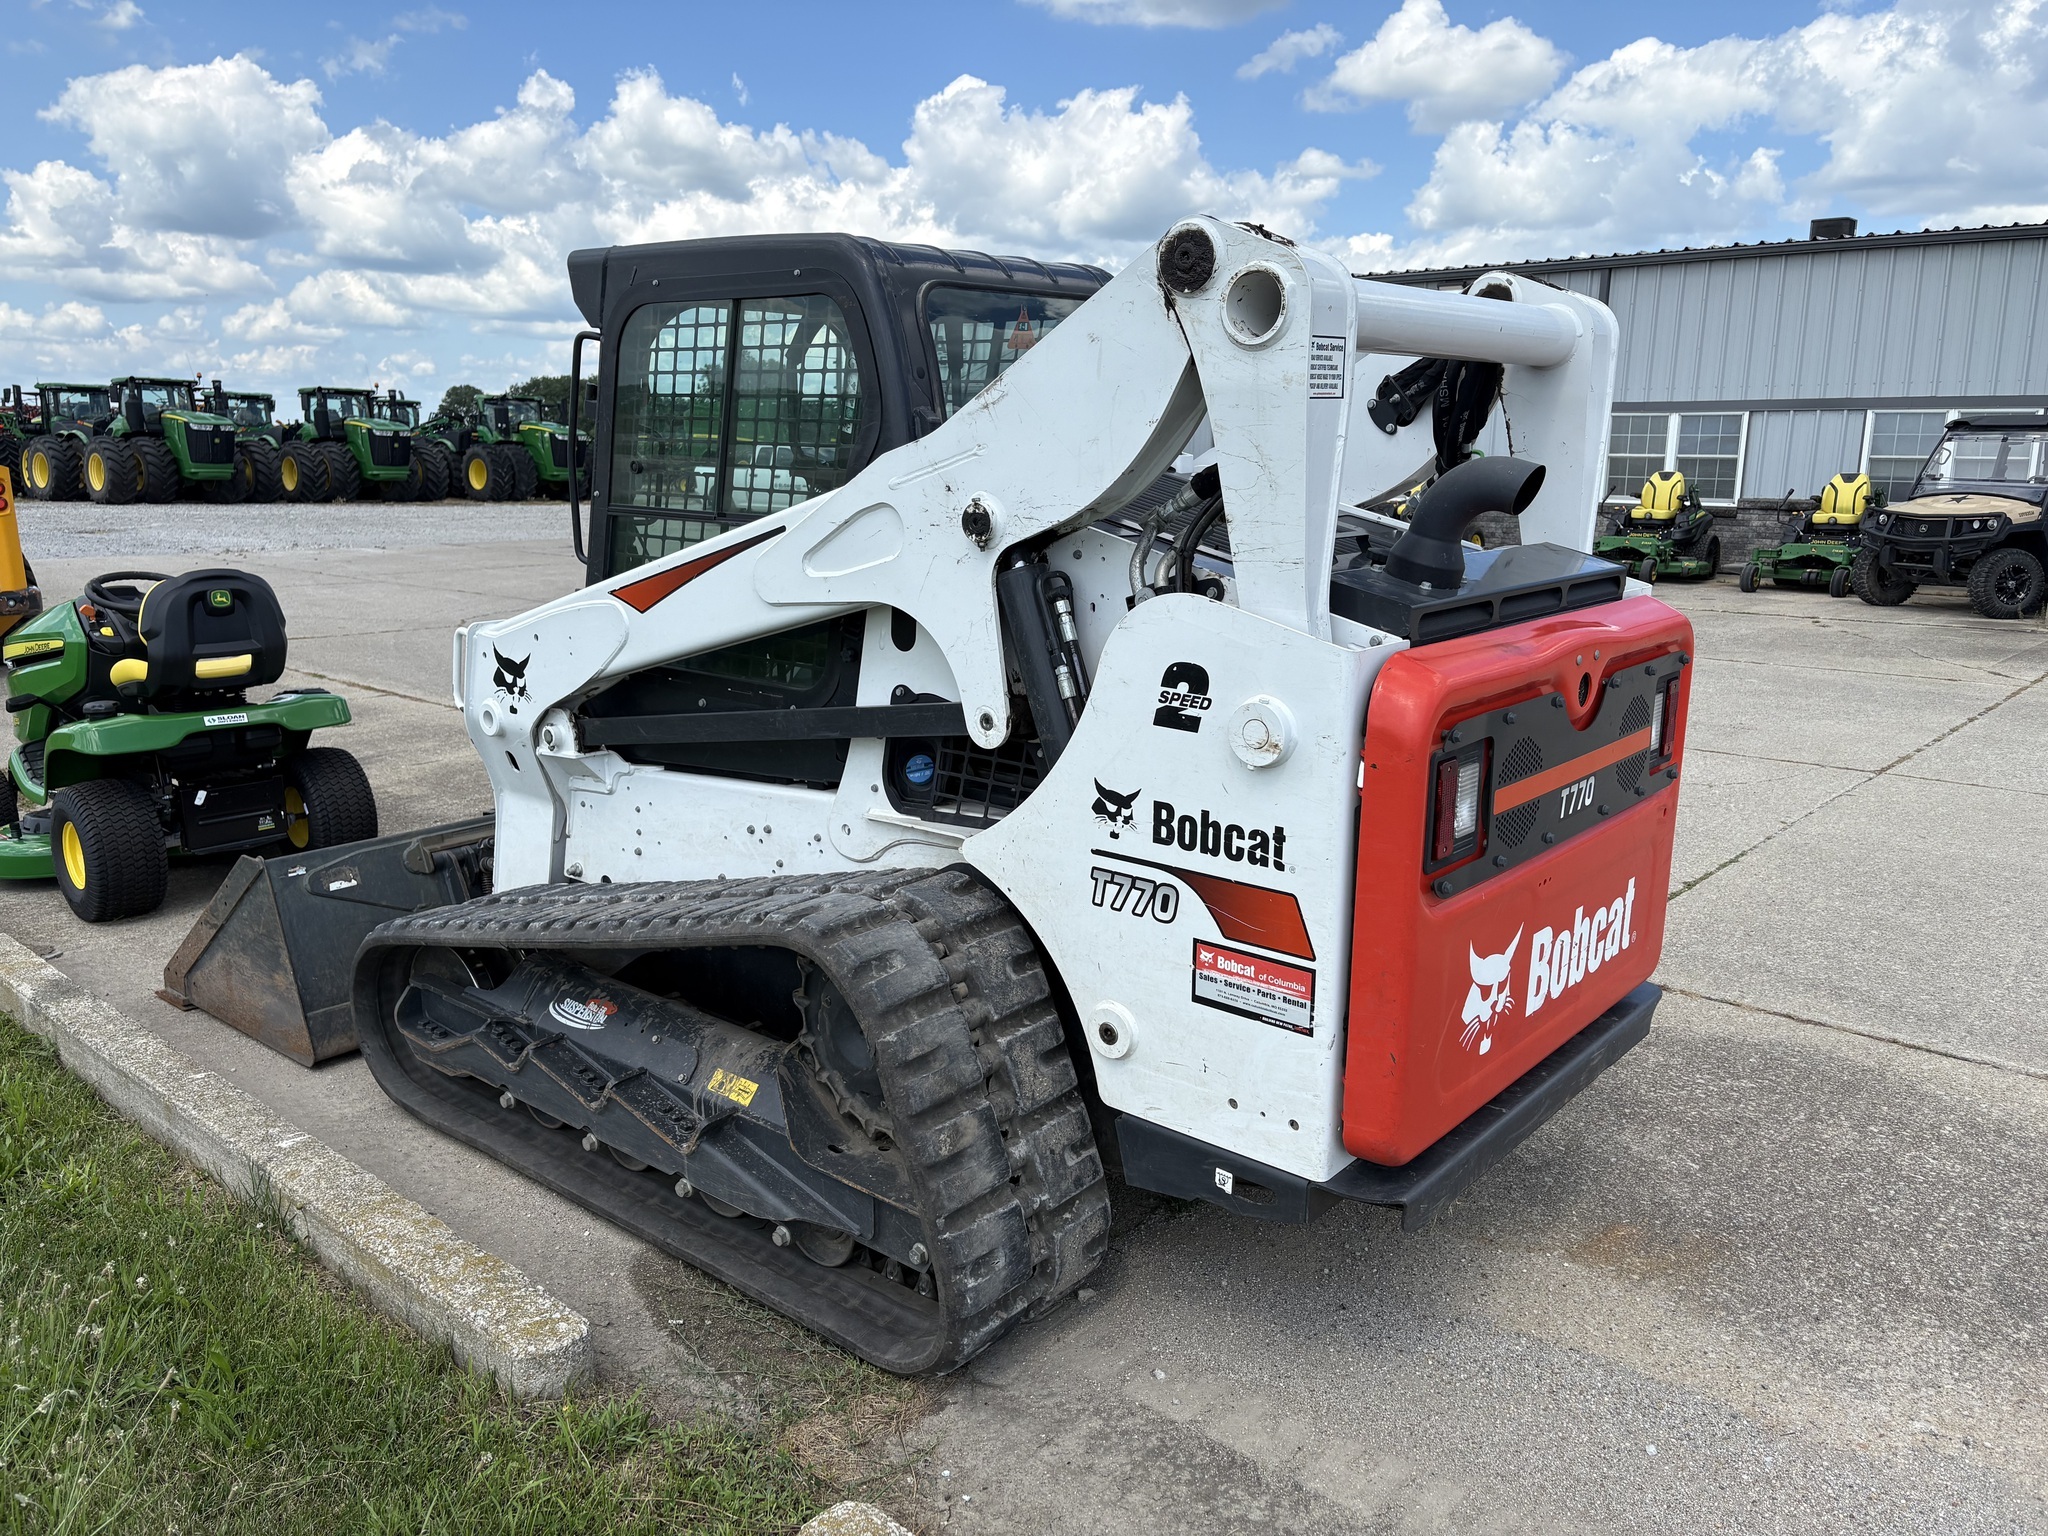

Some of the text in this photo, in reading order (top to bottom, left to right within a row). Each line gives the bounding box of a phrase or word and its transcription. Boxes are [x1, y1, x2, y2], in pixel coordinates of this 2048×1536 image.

[24, 642, 50, 654] JOHN DEERE
[1152, 661, 1210, 734] 2
[1158, 690, 1213, 711] SPEED
[1560, 775, 1596, 819] T770
[1152, 800, 1287, 872] Bobcat
[1090, 866, 1180, 924] T770
[1525, 876, 1637, 1018] Bobcat
[1198, 972, 1218, 985] Sales
[1223, 979, 1251, 994] Service
[1256, 987, 1277, 1001] Parts
[1282, 995, 1307, 1010] Rental
[1217, 956, 1306, 993] Bobcat of Columbia
[563, 997, 609, 1025] SUSPENSION
